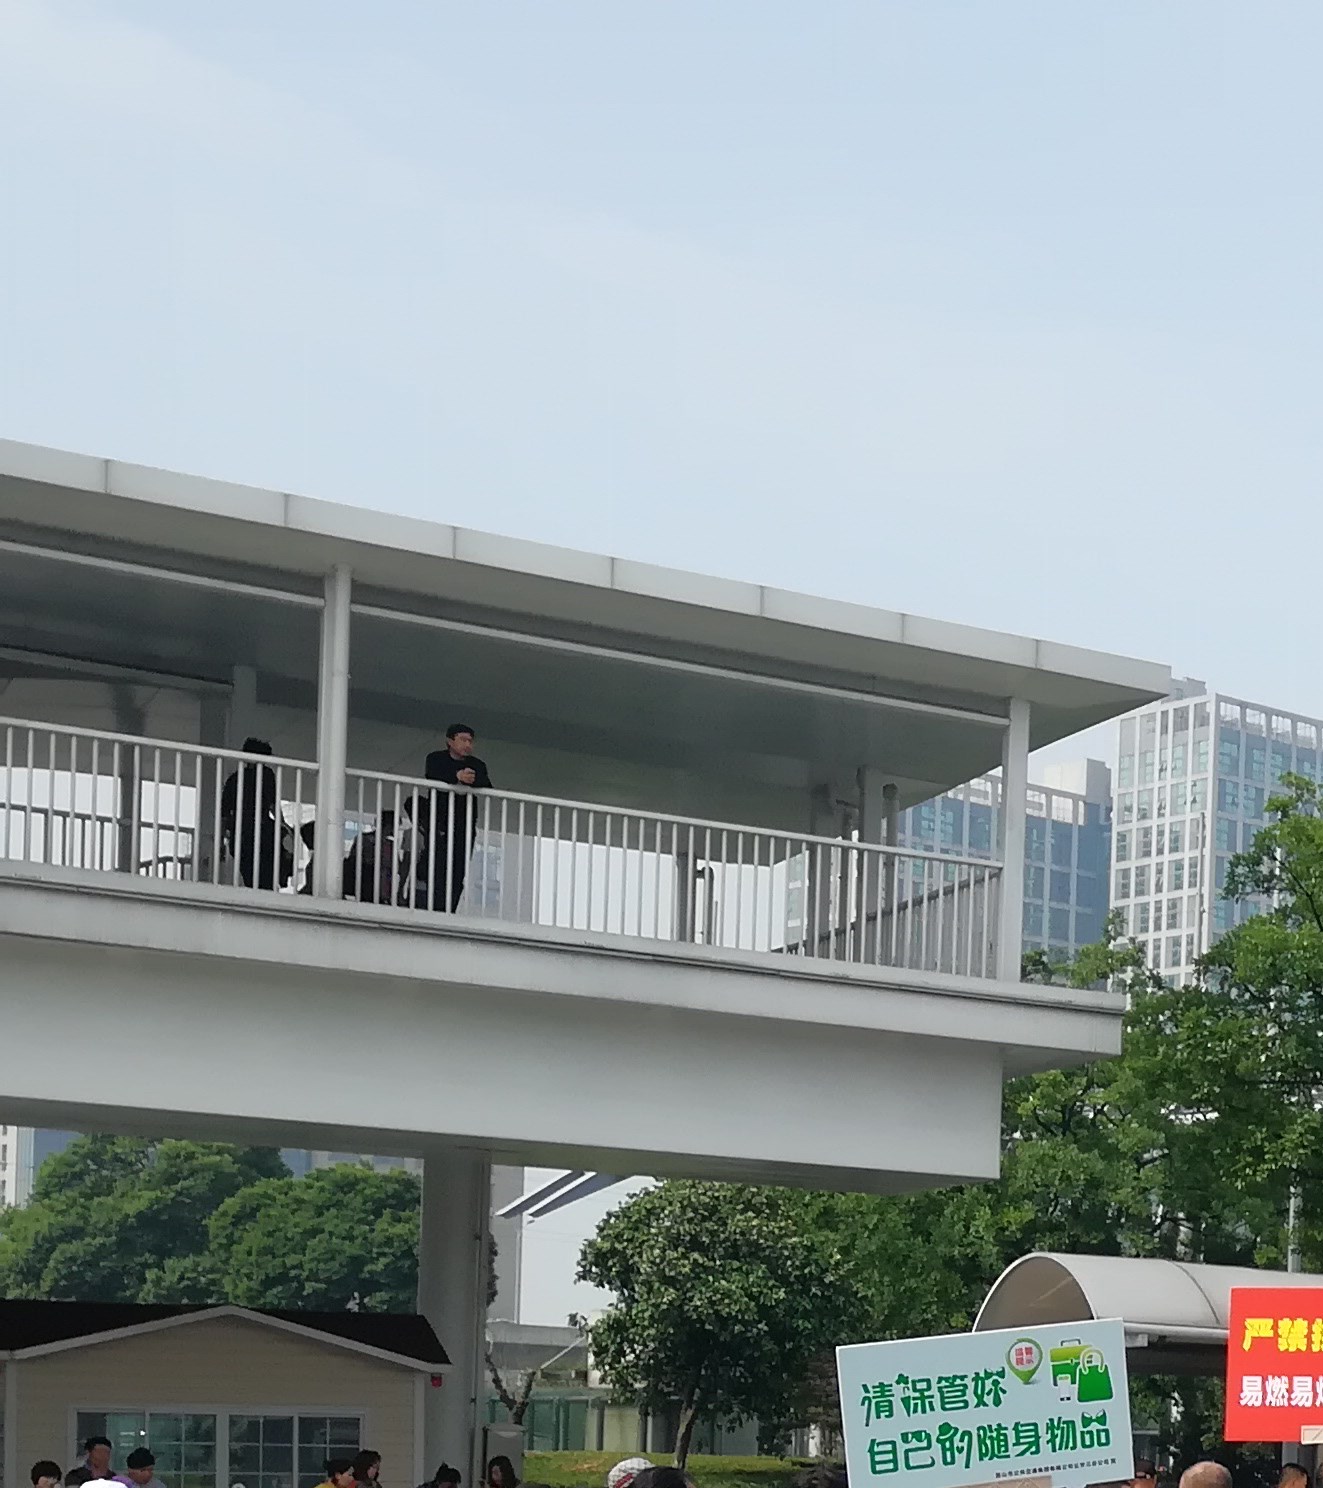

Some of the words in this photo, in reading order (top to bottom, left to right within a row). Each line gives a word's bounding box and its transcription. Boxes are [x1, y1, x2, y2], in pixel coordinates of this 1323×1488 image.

[860, 1366, 1008, 1427] 请保管好
[867, 1408, 1112, 1475] 自己的随身物品
